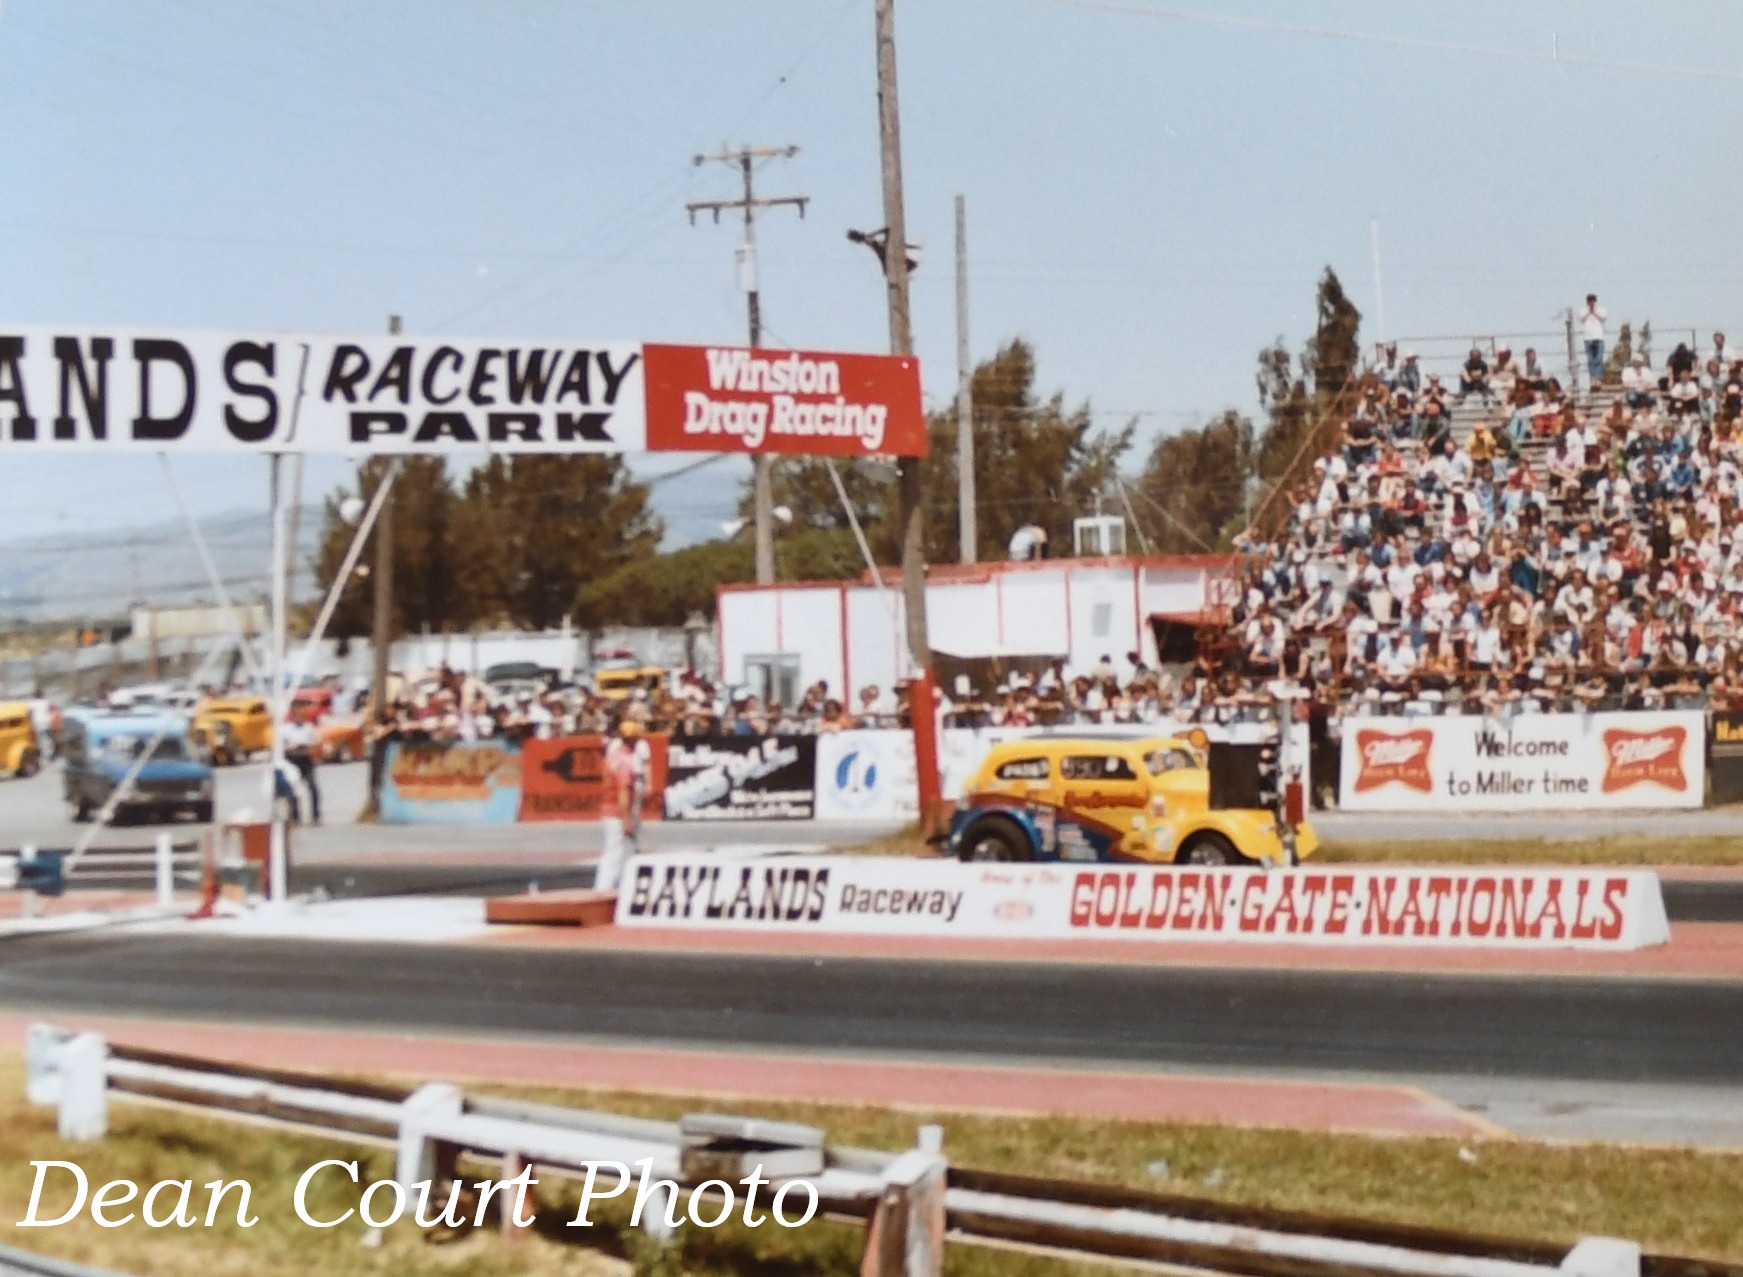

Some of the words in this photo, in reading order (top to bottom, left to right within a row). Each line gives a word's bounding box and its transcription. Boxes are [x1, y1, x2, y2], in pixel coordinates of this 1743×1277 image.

[322, 344, 642, 406] RACEWAY
[706, 349, 841, 394] Winston
[349, 411, 613, 443] PARK
[683, 391, 768, 448] Drag
[770, 394, 888, 450] Racing
[1474, 729, 1569, 758] Welcome
[1446, 772, 1471, 796] to
[1475, 771, 1535, 795] Miller
[1542, 771, 1589, 794] time
[629, 865, 830, 921] BAYLANDS
[839, 882, 963, 922] Raceway
